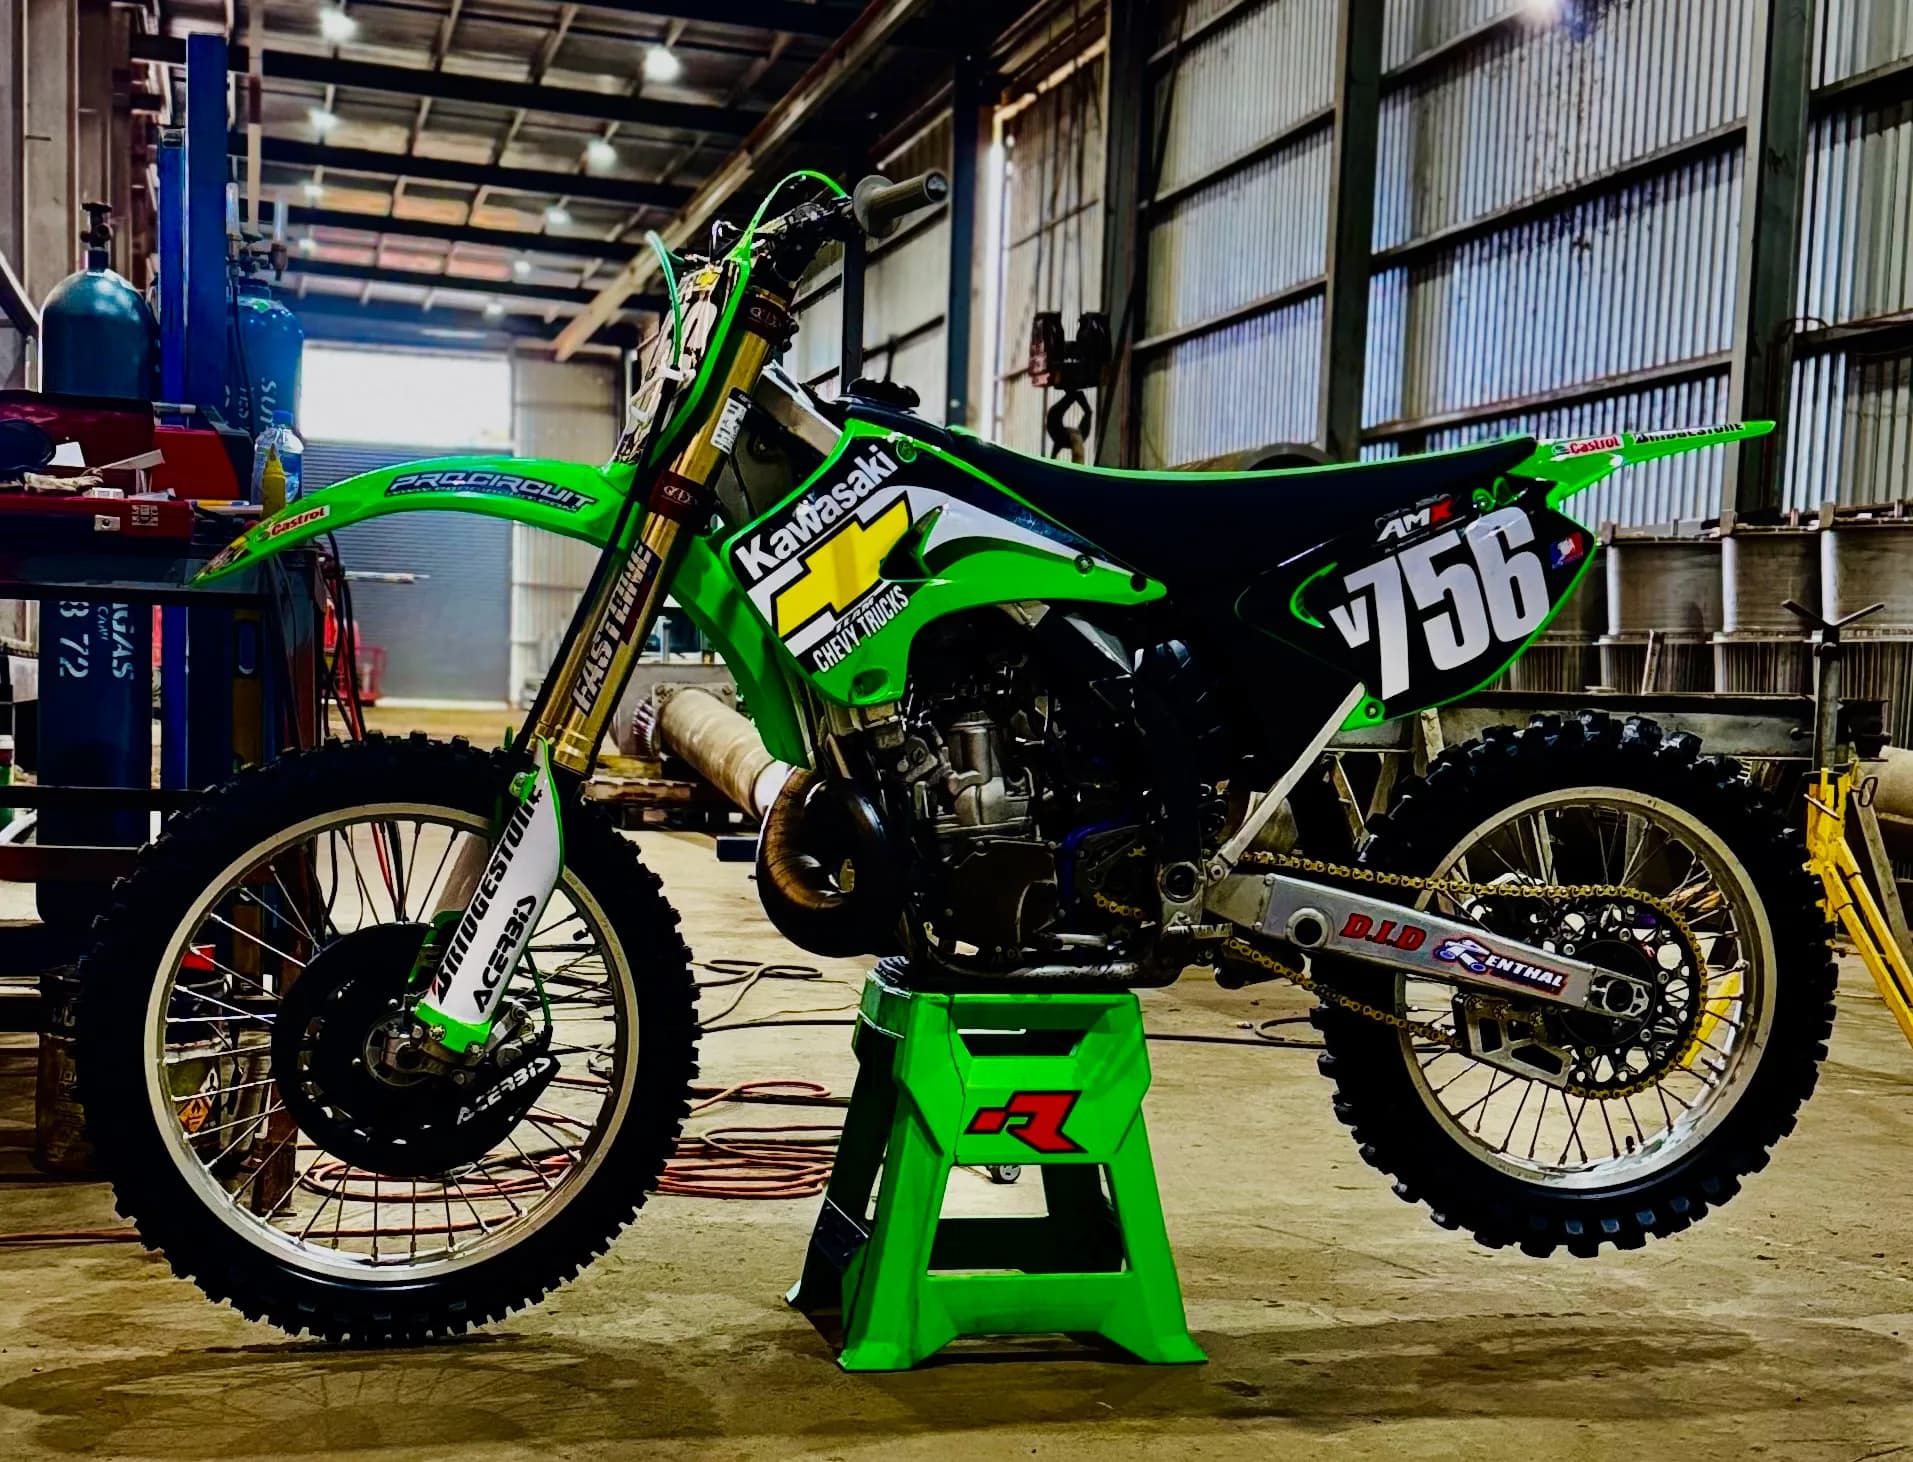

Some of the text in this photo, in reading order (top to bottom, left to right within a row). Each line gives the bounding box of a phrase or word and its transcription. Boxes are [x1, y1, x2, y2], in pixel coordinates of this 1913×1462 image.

[1569, 437, 1621, 455] Castrol
[271, 507, 325, 536] Castrol
[735, 444, 899, 581] Kawasaki
[812, 584, 909, 673] CHEVY TRUCKS
[437, 786, 543, 1006] BRIDGESTONE
[473, 895, 537, 1014] ACERBIS
[456, 1055, 551, 1125] ACERBIS
